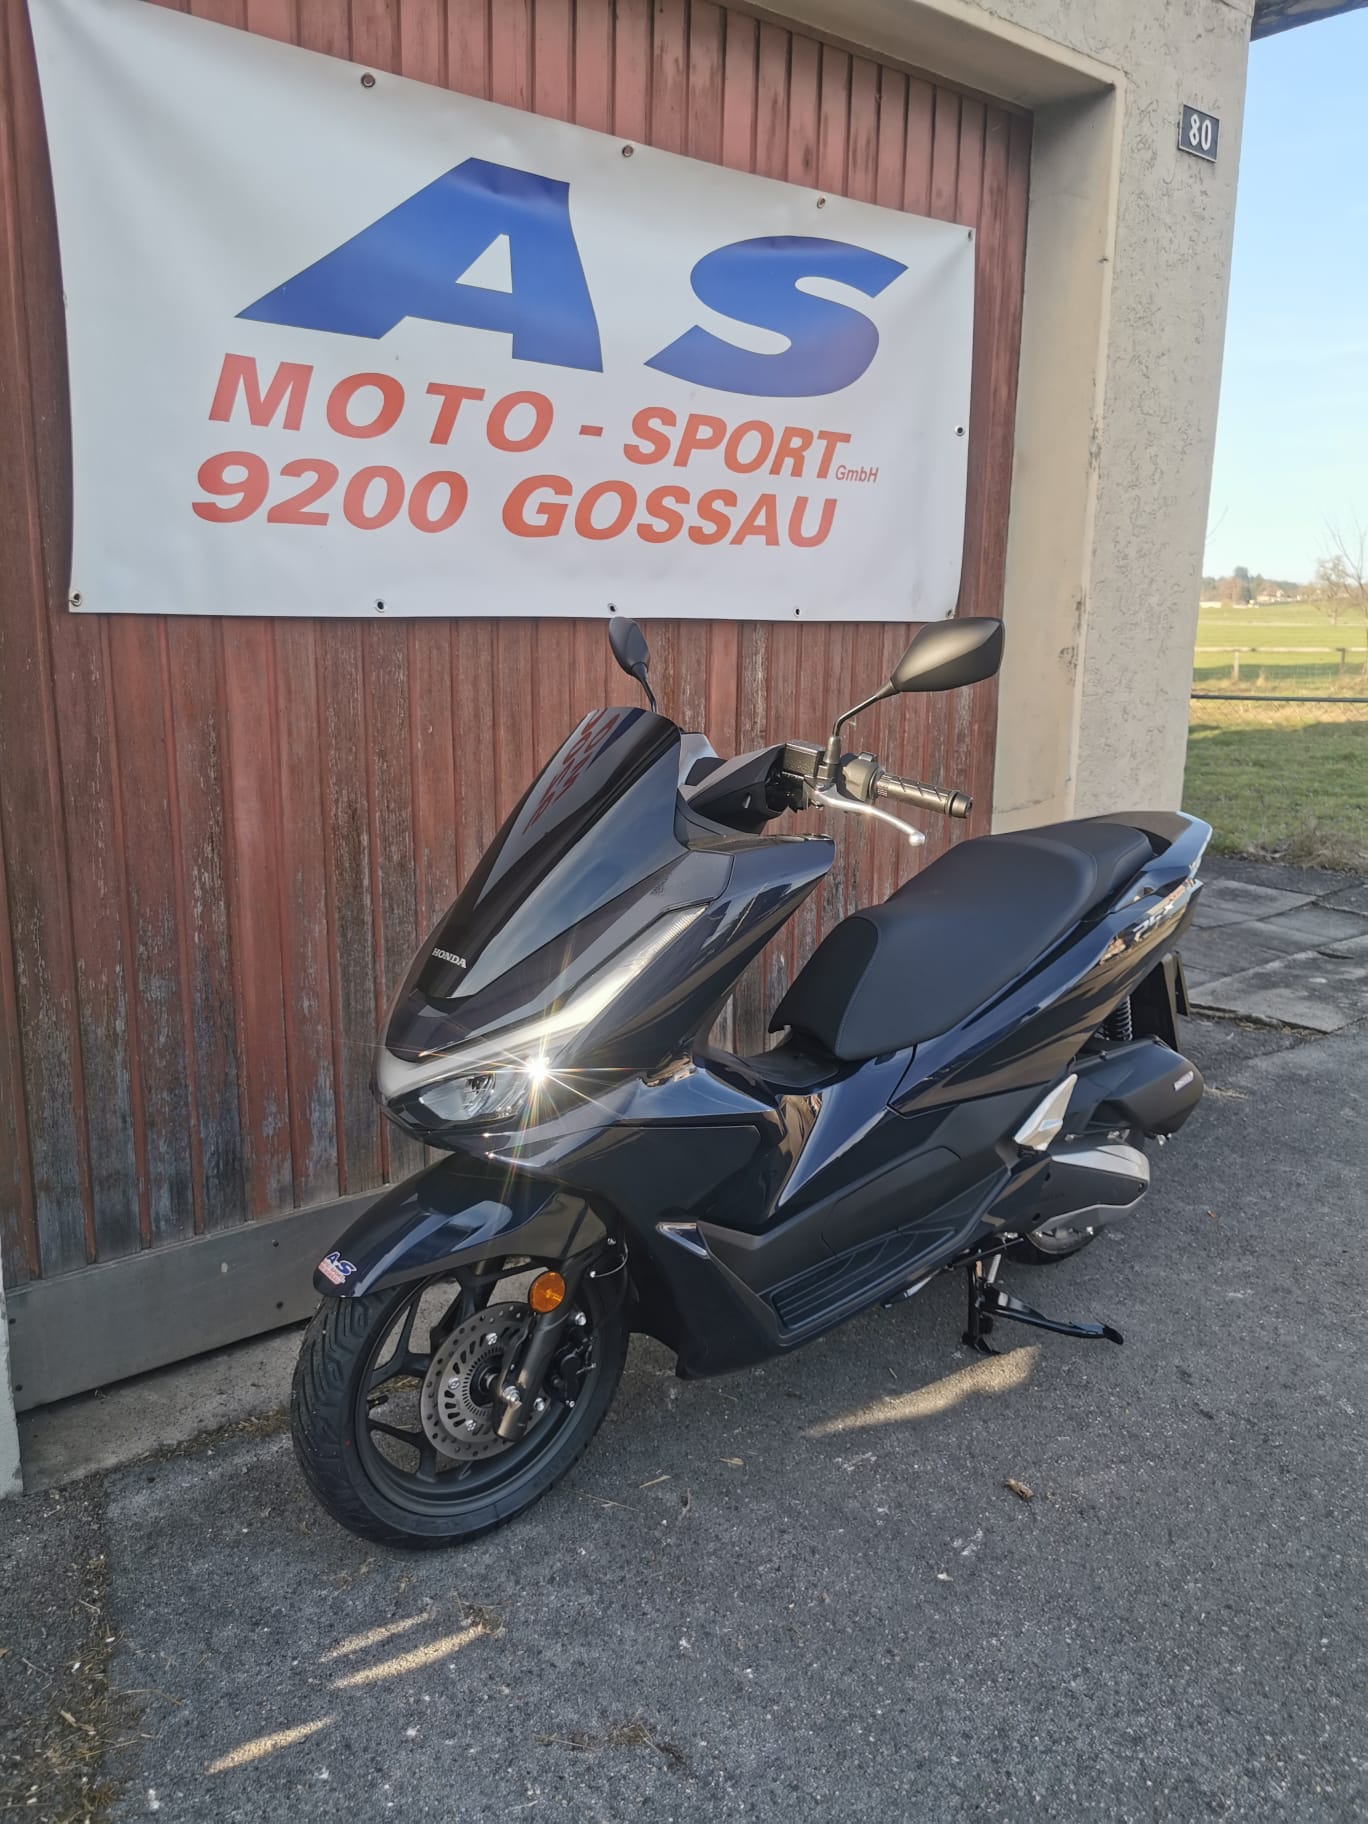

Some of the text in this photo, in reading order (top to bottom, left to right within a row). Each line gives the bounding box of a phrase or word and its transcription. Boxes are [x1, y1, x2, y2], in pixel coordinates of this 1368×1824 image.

[1188, 113, 1212, 151] 80
[209, 353, 555, 454] MOTO
[623, 407, 851, 480] SPORT
[835, 464, 879, 483] GmbH
[191, 451, 838, 548] 9200 GOSSAU
[431, 947, 467, 969] HONDA
